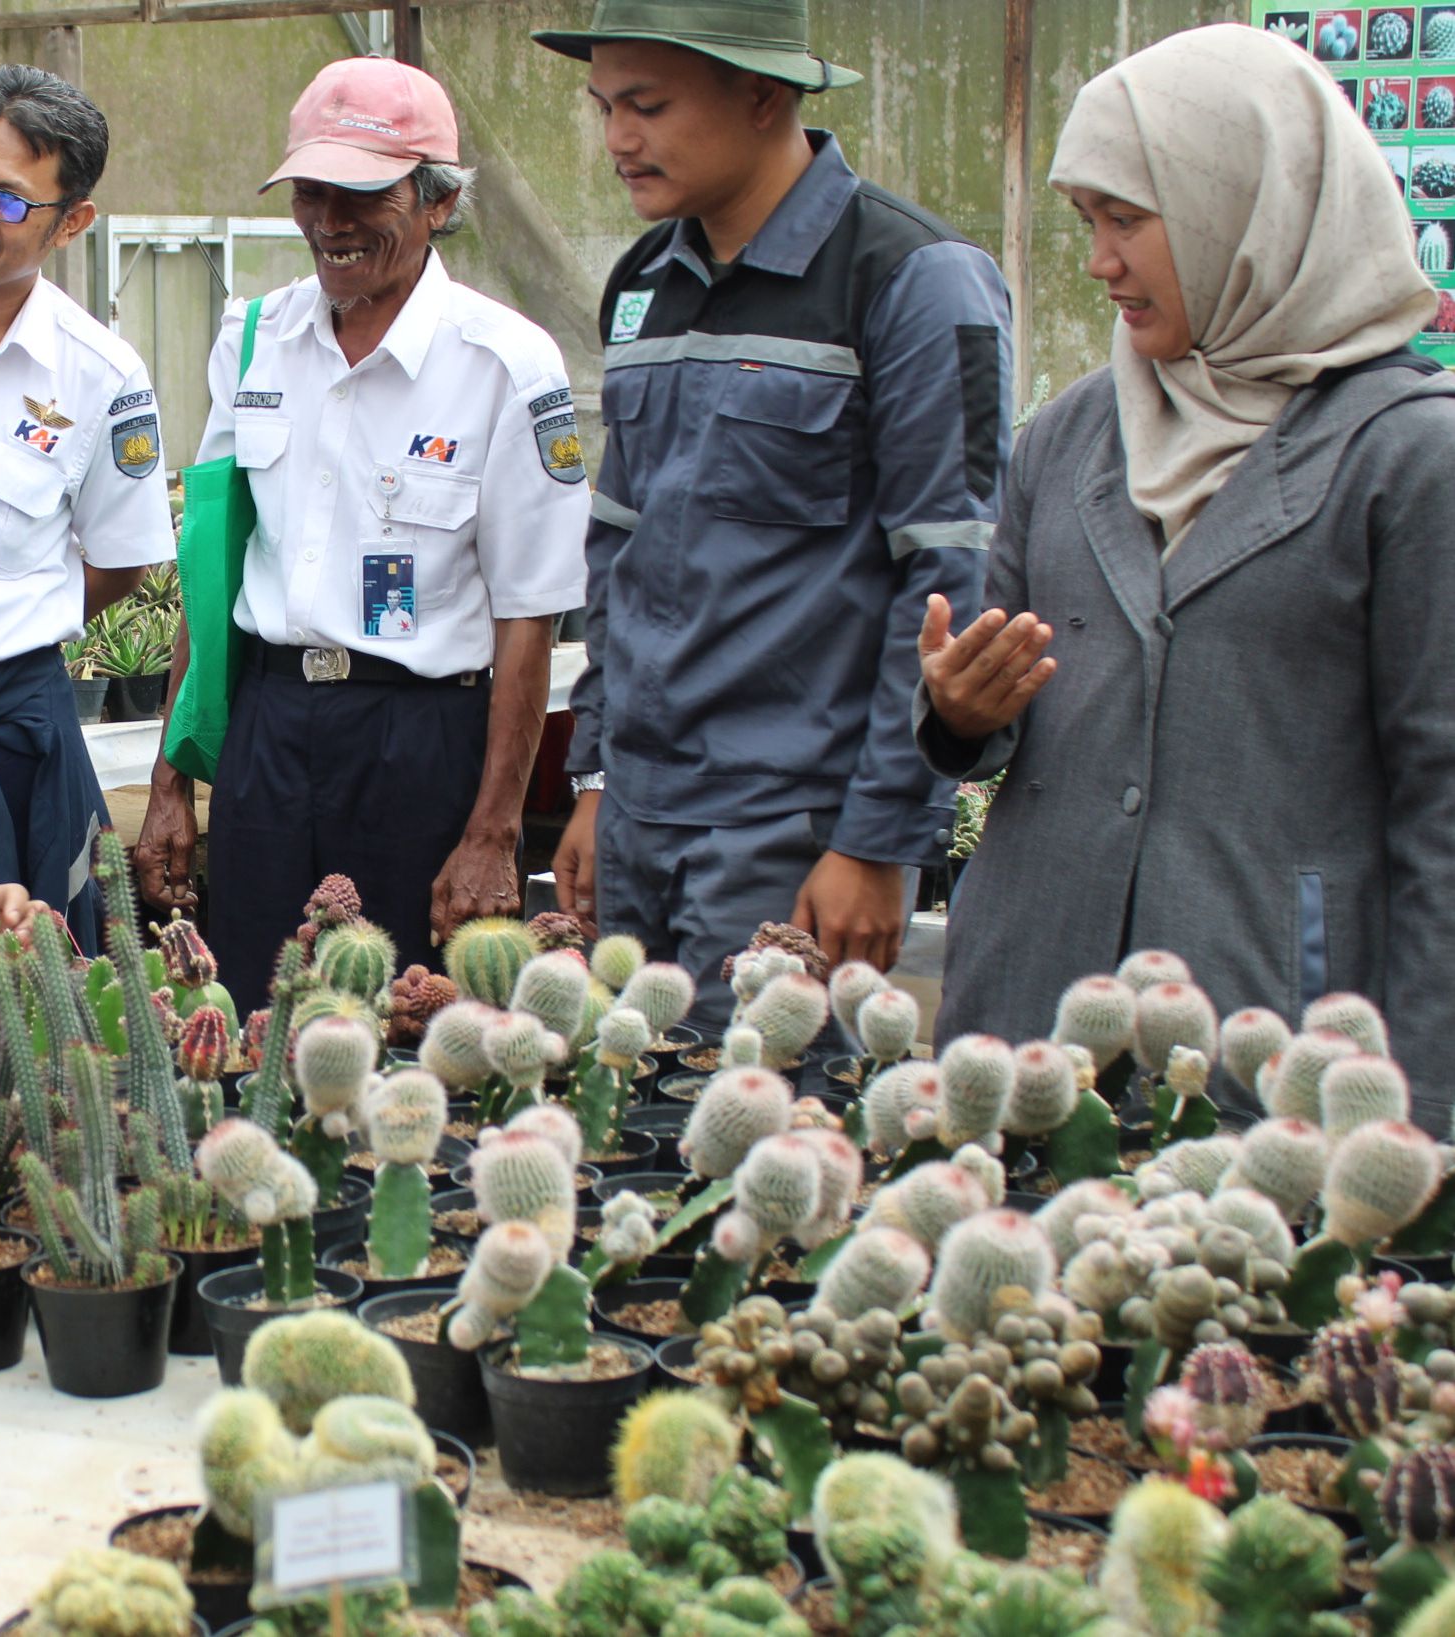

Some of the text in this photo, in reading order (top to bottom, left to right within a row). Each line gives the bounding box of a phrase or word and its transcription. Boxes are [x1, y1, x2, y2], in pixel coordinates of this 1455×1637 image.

[338, 118, 400, 136] Enduro
[110, 394, 143, 413] DAOP
[532, 392, 568, 413] DAOP
[14, 419, 59, 454] KAI
[408, 434, 457, 463] KAI
